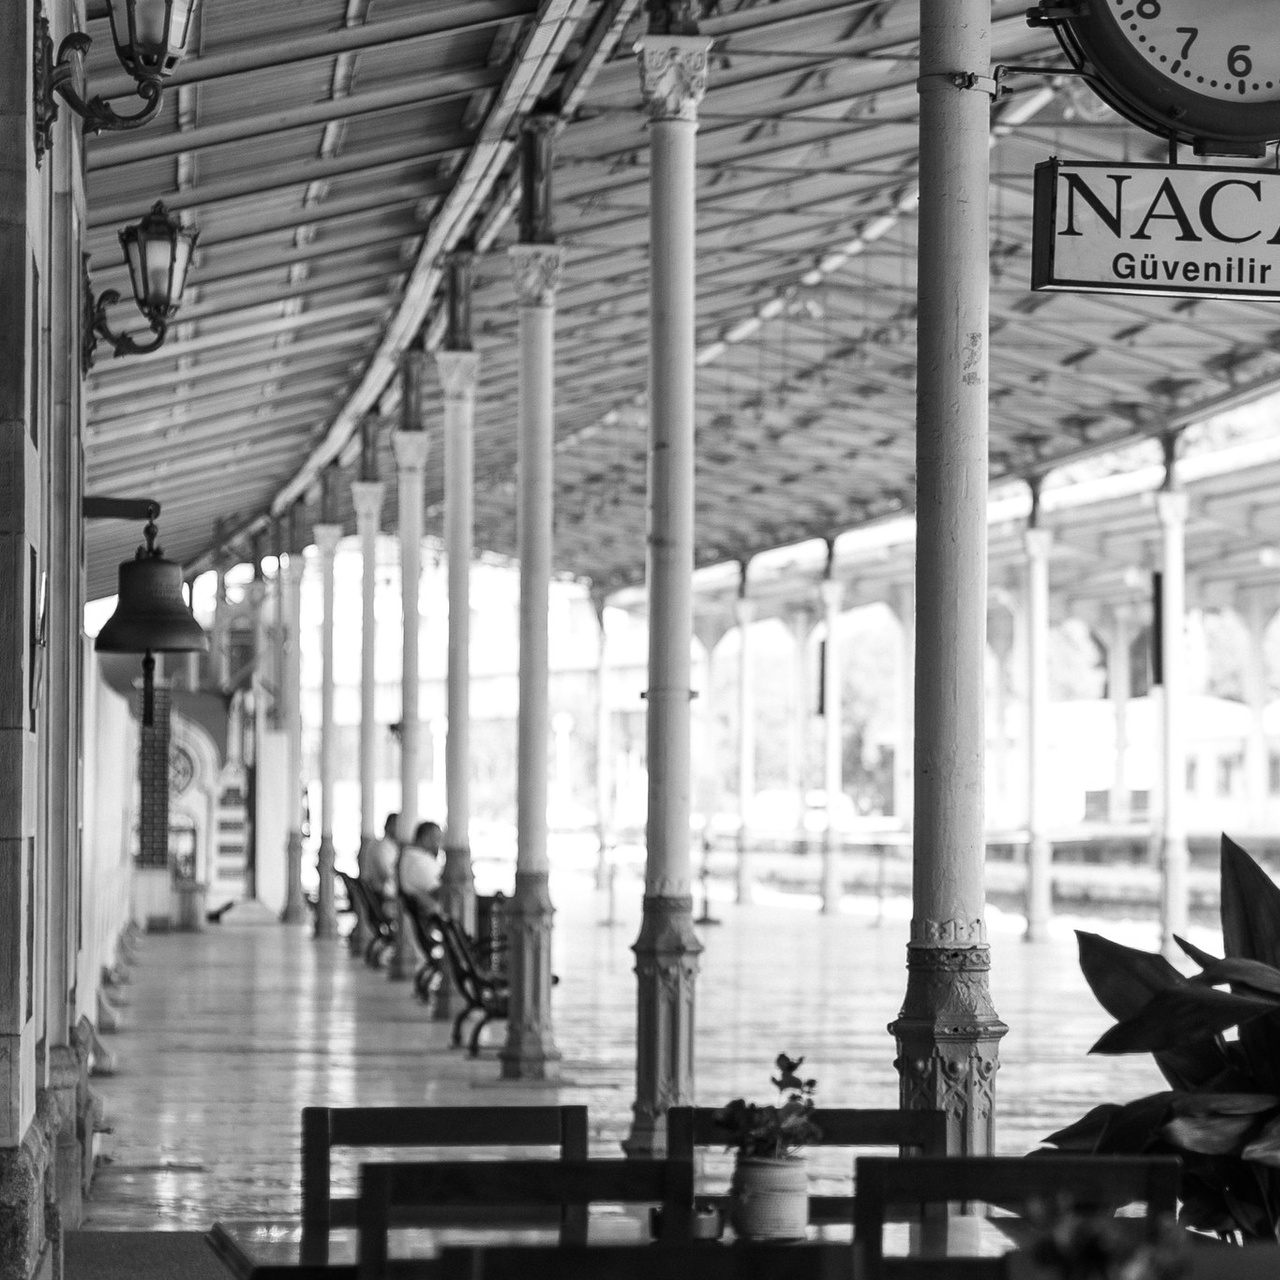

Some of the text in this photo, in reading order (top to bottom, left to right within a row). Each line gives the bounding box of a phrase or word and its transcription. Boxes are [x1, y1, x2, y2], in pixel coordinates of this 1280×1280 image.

[1176, 26, 1199, 61] 7
[1227, 44, 1253, 78] 6
[1112, 252, 1272, 285] Güvenilir
